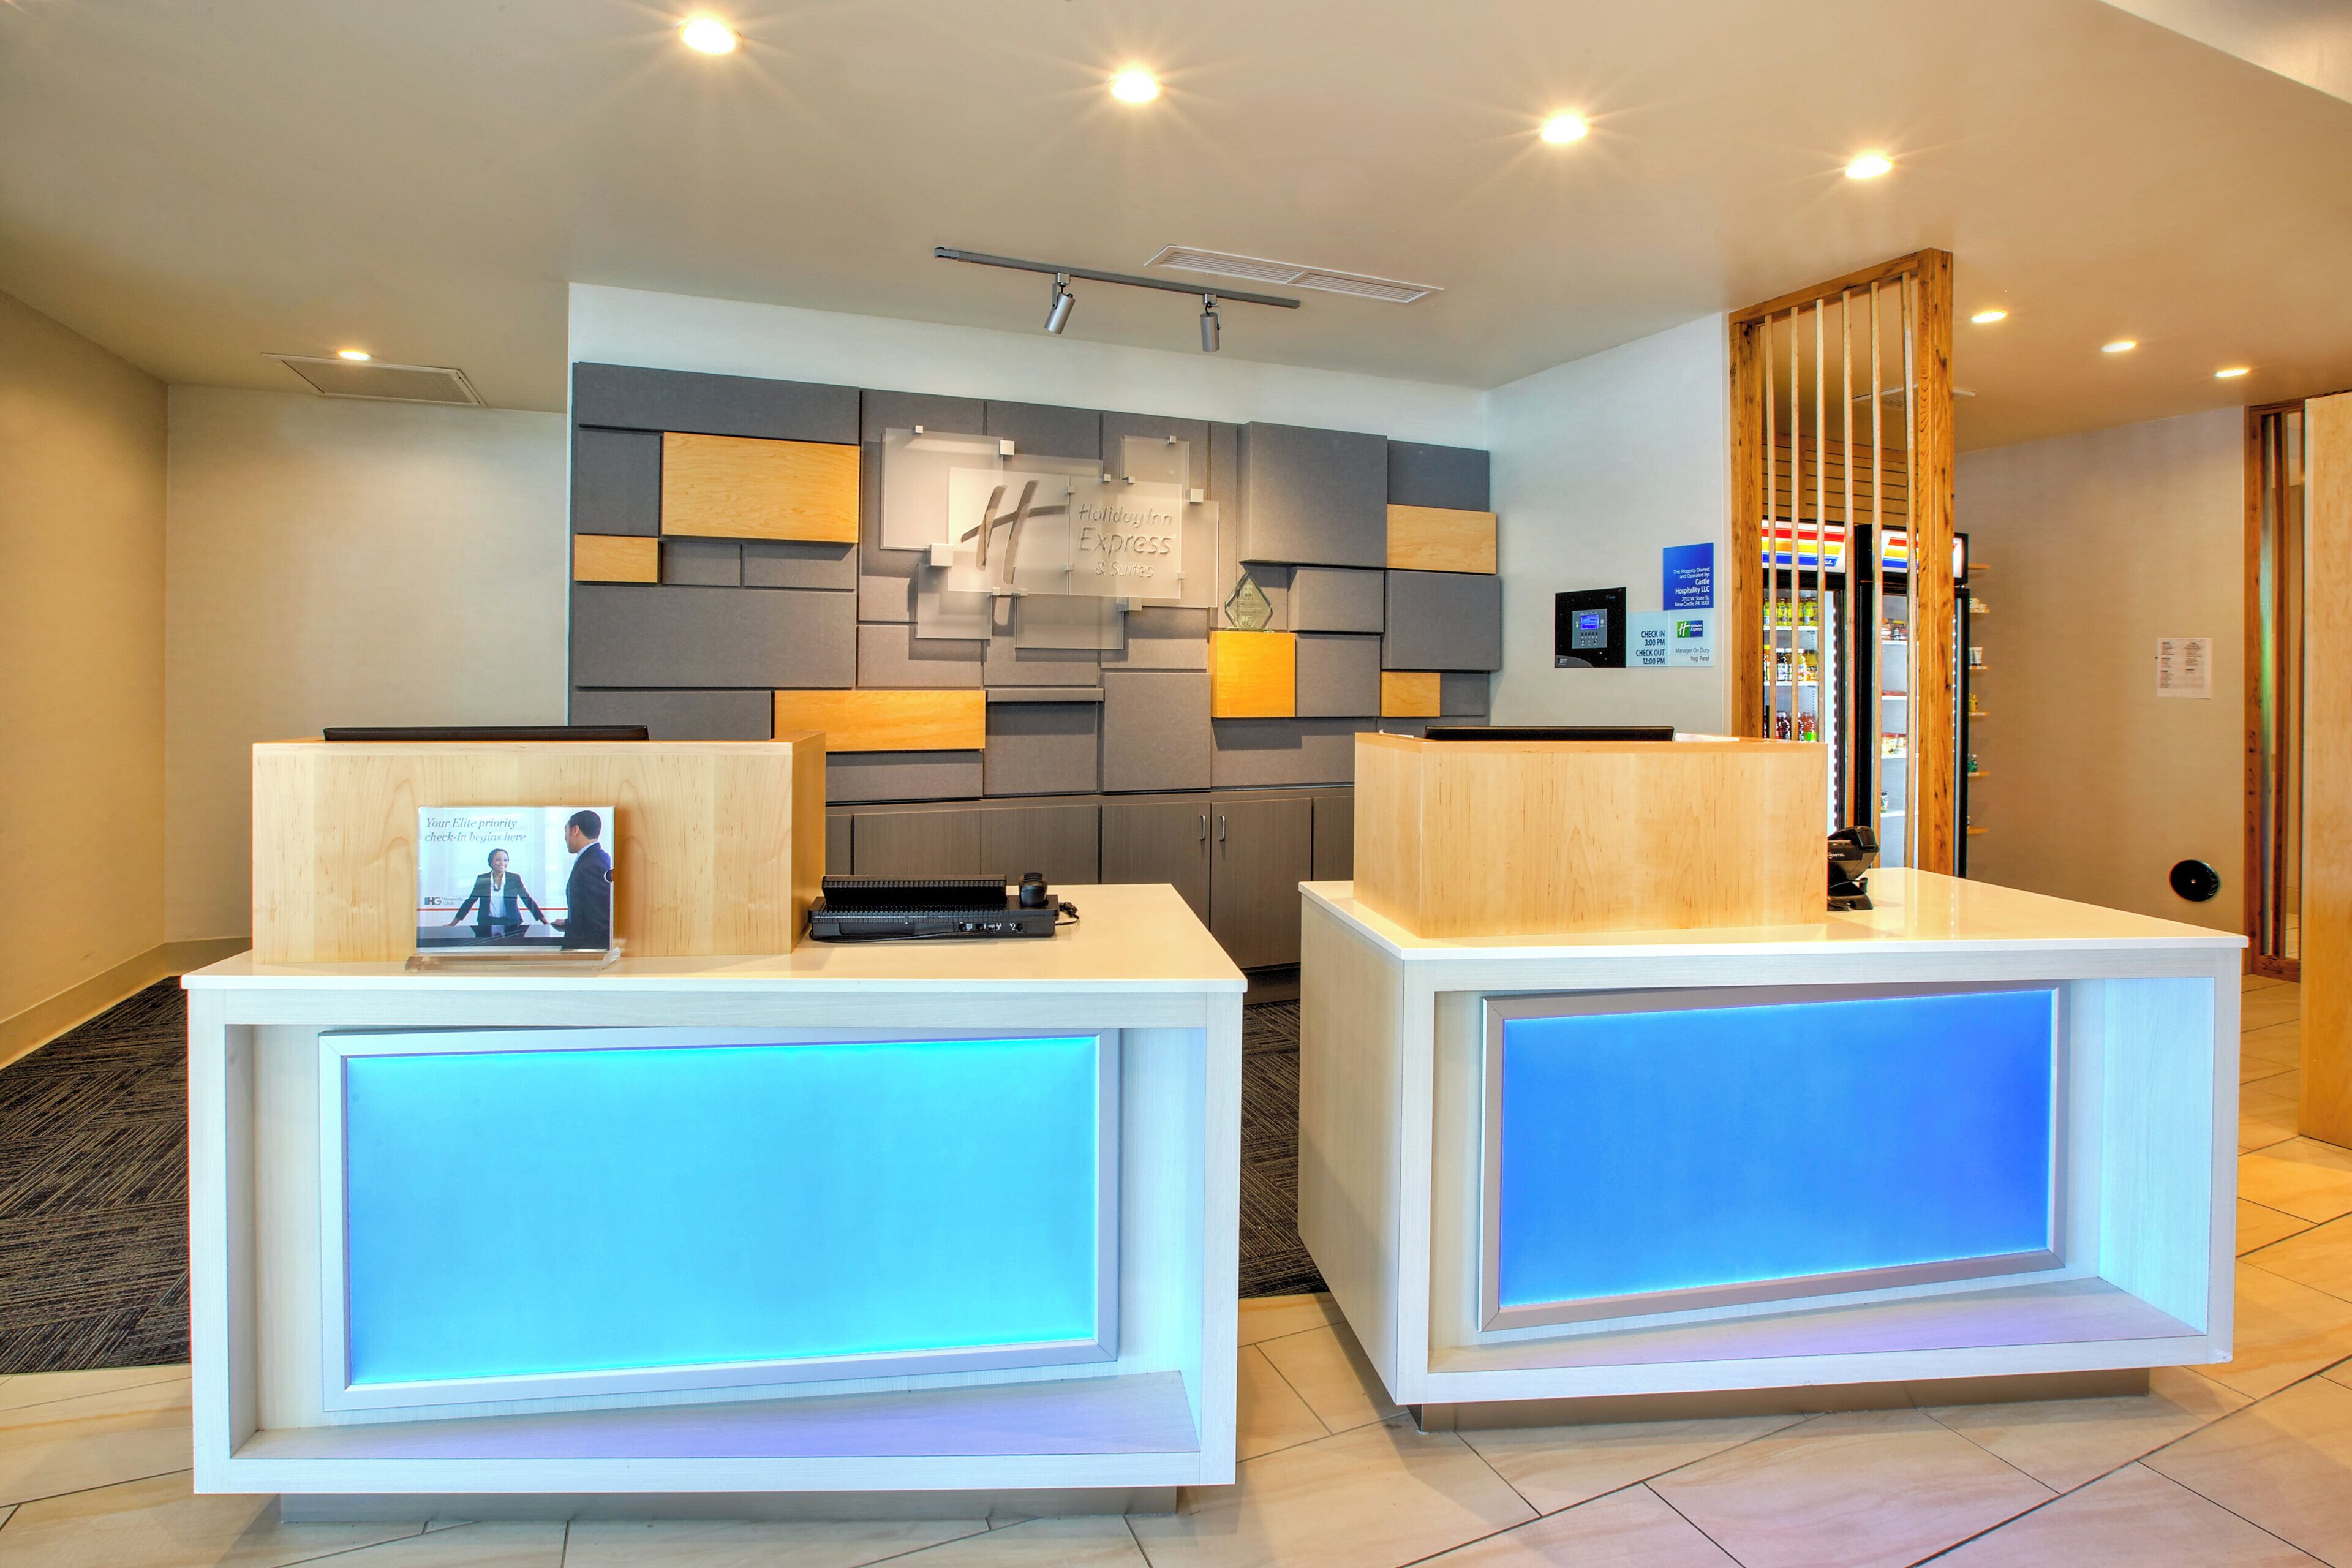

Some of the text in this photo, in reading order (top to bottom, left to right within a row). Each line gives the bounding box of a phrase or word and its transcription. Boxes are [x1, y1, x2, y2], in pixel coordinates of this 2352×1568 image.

[1079, 503, 1172, 528] Holiday Inn
[1079, 527, 1172, 558] Express
[1095, 560, 1156, 577] & Suites
[427, 818, 518, 829] Your Elite priority
[425, 832, 526, 843] check-in begins here
[424, 897, 442, 905] IHG
